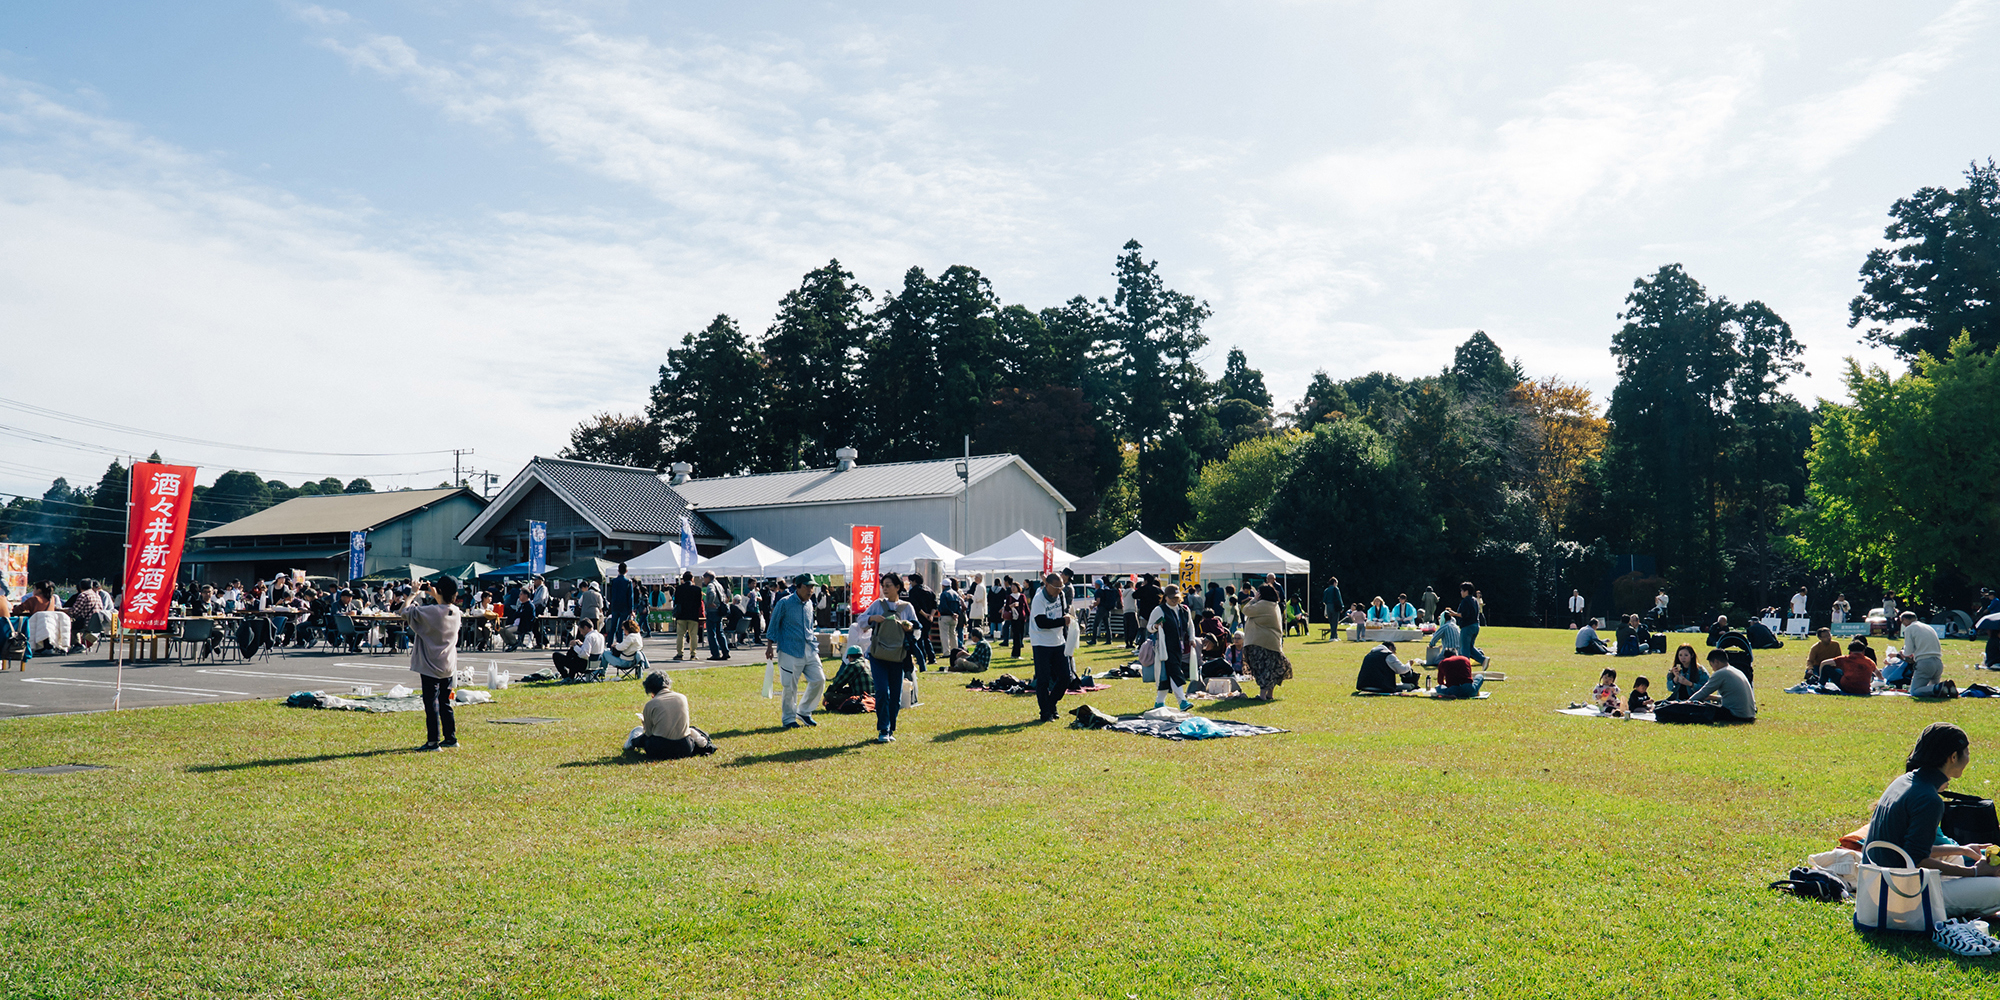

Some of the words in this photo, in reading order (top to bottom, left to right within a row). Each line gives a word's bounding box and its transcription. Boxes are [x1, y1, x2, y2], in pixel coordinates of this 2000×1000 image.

[128, 472, 181, 615] 酒々井新酒祭
[859, 531, 875, 609] 酒々井新酒祭
